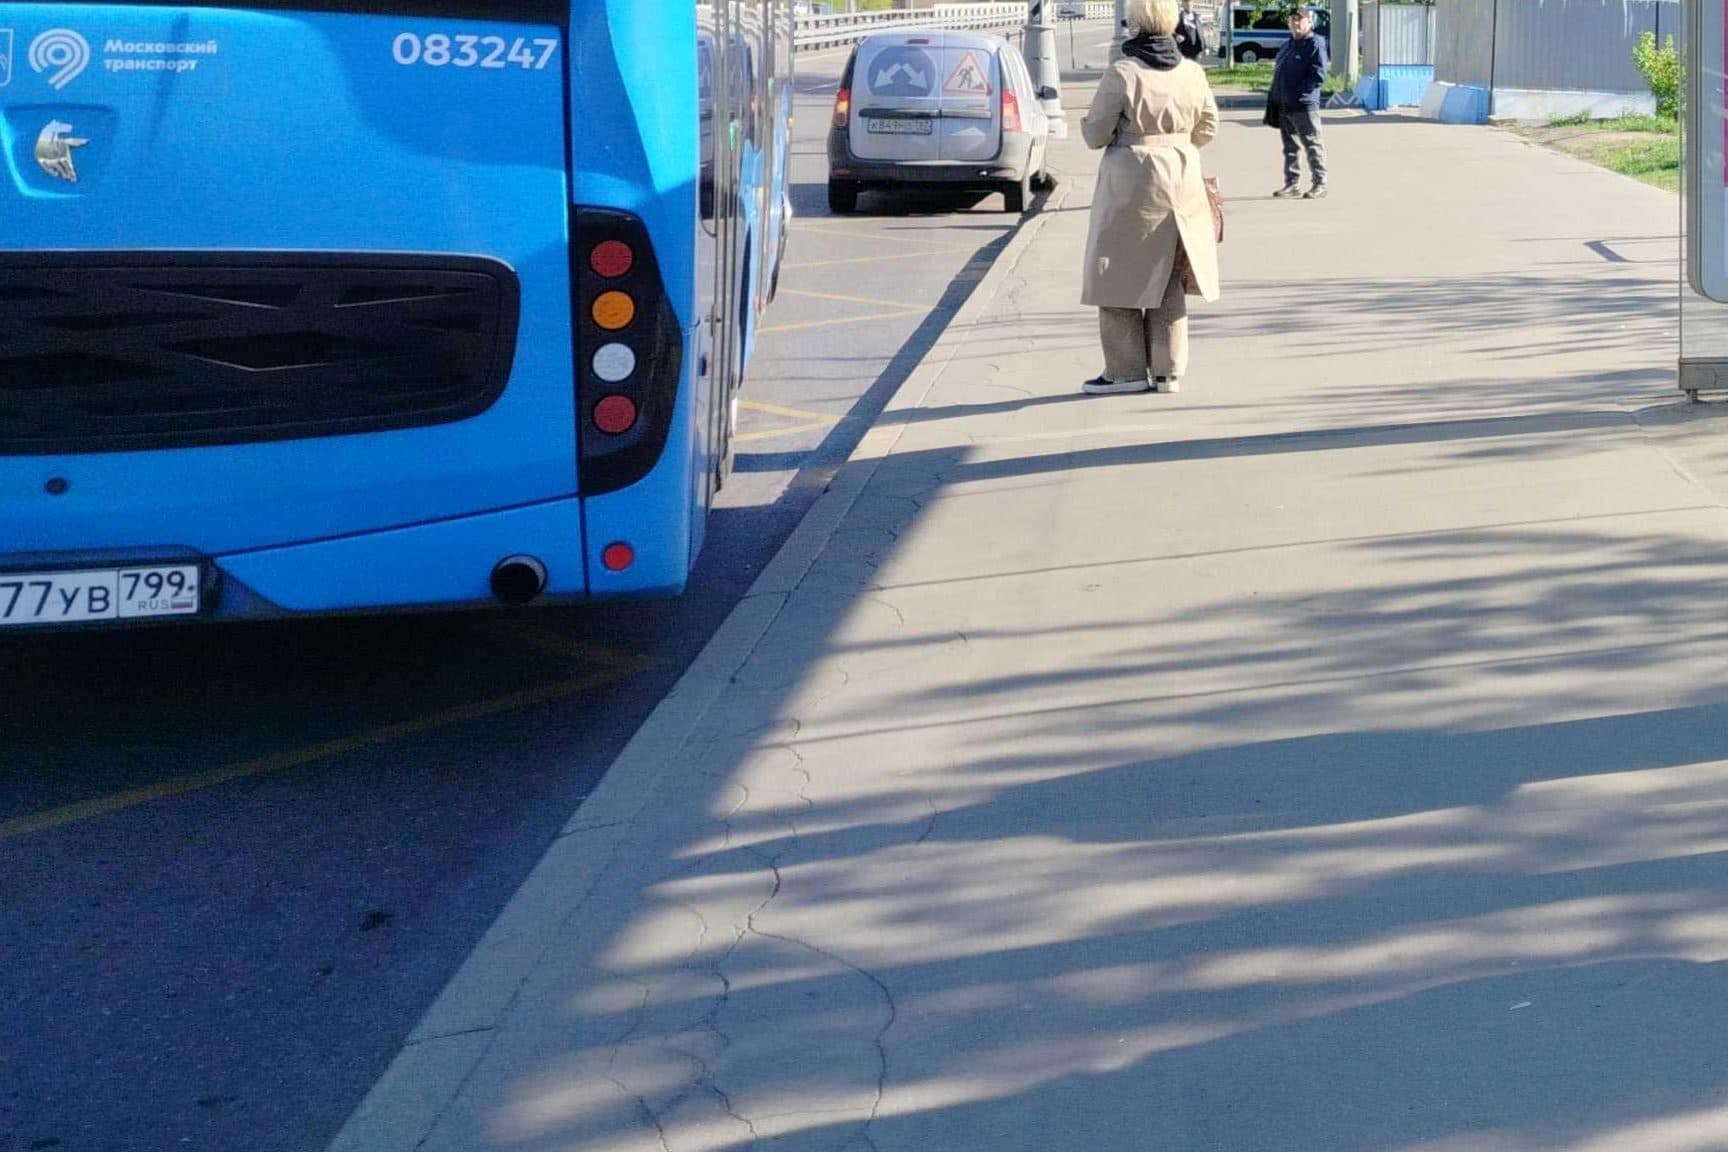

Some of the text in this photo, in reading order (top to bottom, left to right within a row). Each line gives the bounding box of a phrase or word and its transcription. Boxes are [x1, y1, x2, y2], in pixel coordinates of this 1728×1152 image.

[103, 39, 218, 55] Московский
[392, 32, 558, 70] 083247
[103, 58, 199, 73] транспорт
[121, 570, 186, 601] 799
[138, 599, 169, 610] RUS
